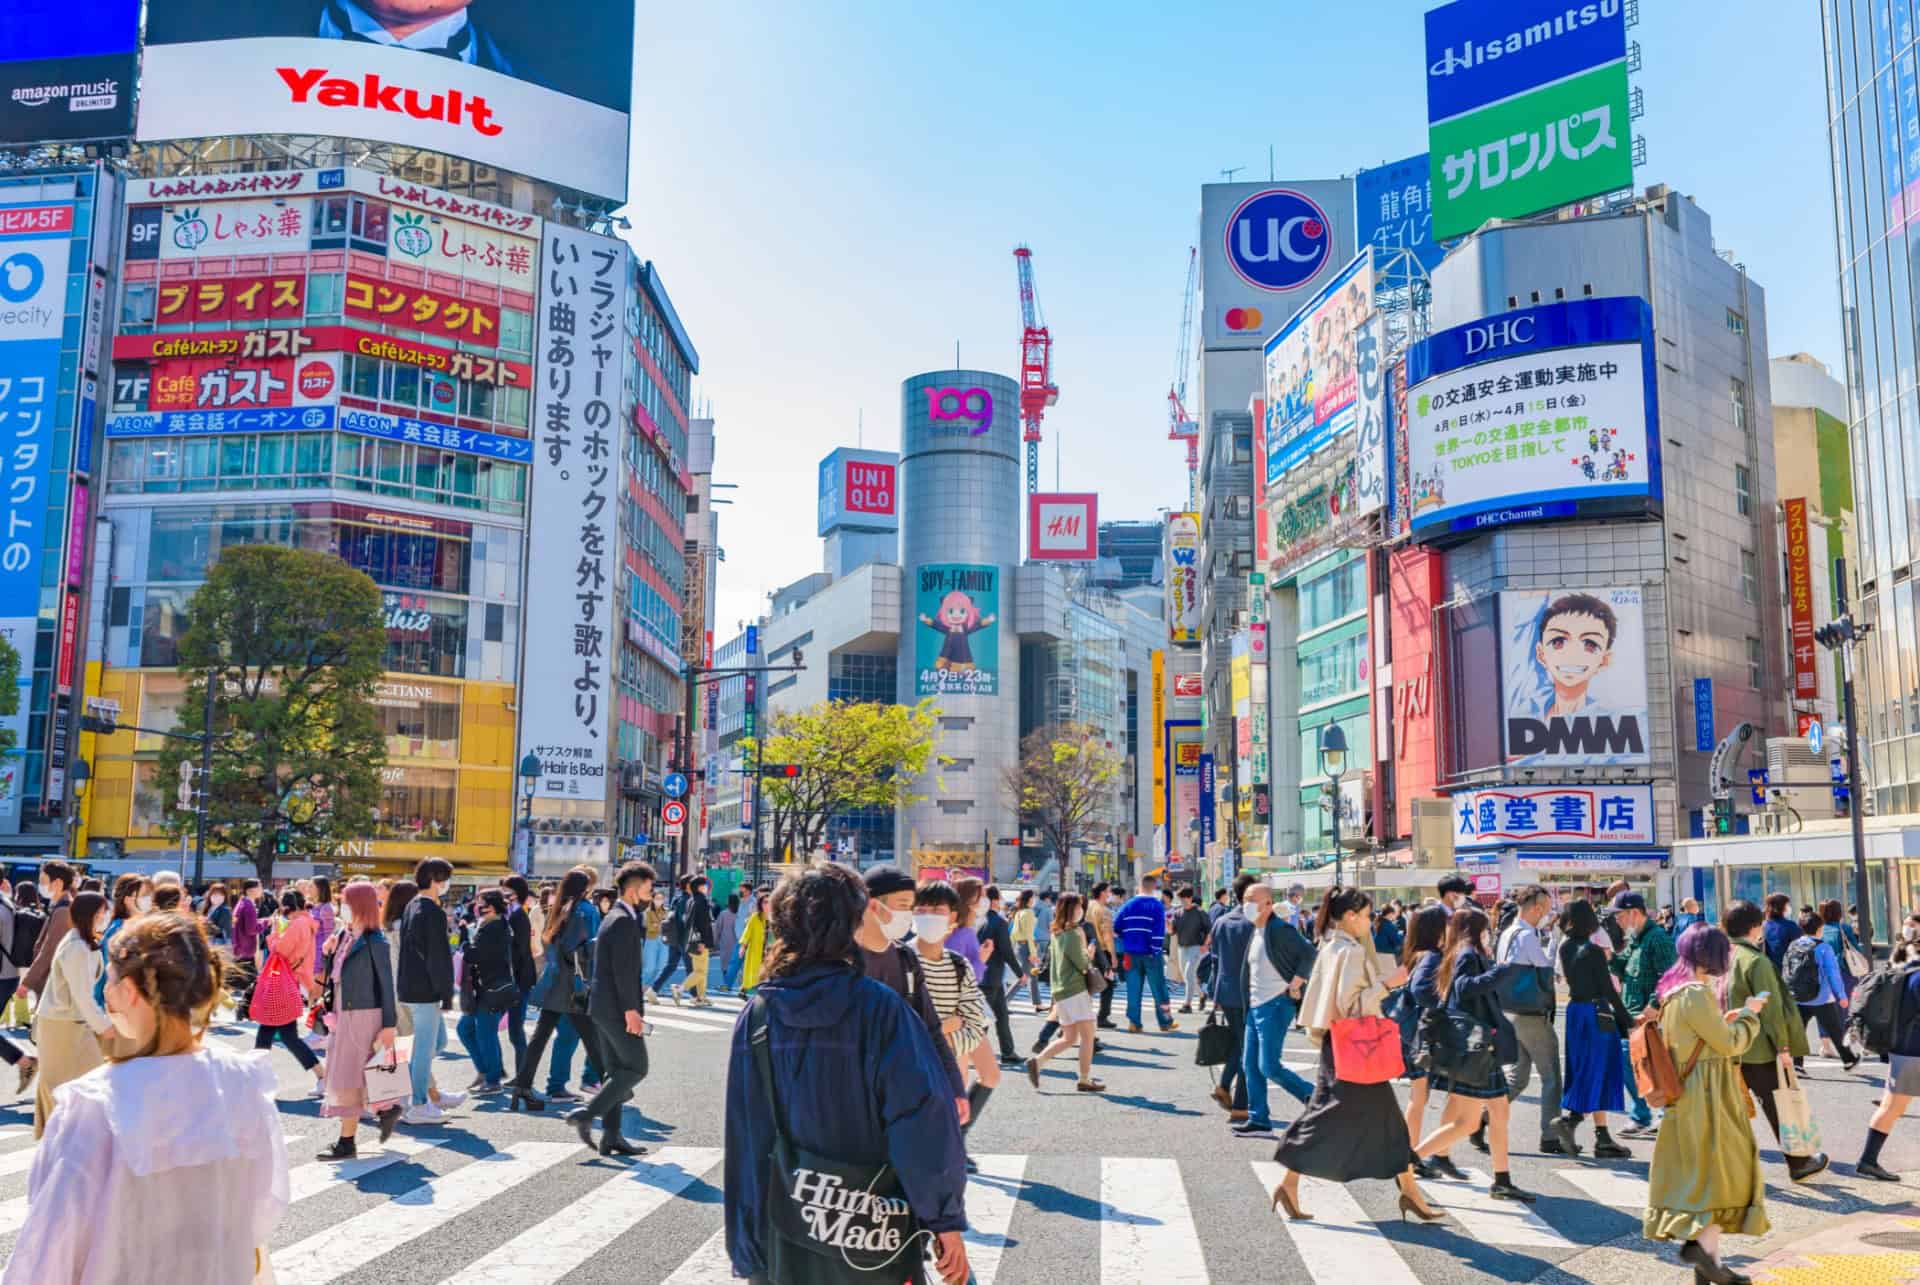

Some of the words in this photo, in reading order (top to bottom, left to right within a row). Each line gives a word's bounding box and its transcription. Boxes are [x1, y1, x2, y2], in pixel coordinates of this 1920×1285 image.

[1430, 0, 1619, 76] Hisamitsu
[12, 85, 68, 100] amazon
[71, 78, 118, 96] music
[277, 68, 503, 137] Yakult
[1442, 104, 1617, 200] サロンパス
[149, 173, 304, 198] しゃぶしゃぶバイキング
[379, 176, 534, 231] しゃぶしゃぶバイキング
[1380, 183, 1432, 221] 龍角
[131, 223, 159, 242] 9F
[214, 208, 302, 240] しゃぶ葉
[1239, 216, 1321, 263] UC
[440, 228, 531, 275] しゃぶ葉
[161, 279, 300, 314] プライス
[346, 280, 494, 336] コンタクト
[242, 329, 312, 358] ガスト
[1464, 316, 1536, 355] DHC
[450, 353, 518, 386] ガスト
[544, 237, 580, 481] いい曲あります。
[117, 378, 149, 400] 7F
[157, 376, 194, 393] Café
[197, 368, 286, 407] ガスト
[303, 378, 331, 389] ガスト
[113, 415, 155, 431] AEON
[168, 411, 296, 432] 英会話イーオン
[303, 410, 326, 425] 6F
[924, 386, 993, 436] 109
[346, 411, 394, 433] AEON
[403, 421, 530, 458] 英会話イーオン
[3, 377, 45, 572] コンタクトの
[573, 249, 619, 738] ブラジャーのホックを外す歌より、
[851, 467, 888, 488] UNI
[851, 489, 889, 509] QLO
[1475, 513, 1499, 527] DHC
[1500, 506, 1544, 521] Channel
[1047, 515, 1081, 537] H&M
[1791, 503, 1809, 612] クスリのことなら
[1507, 714, 1645, 756] DMM
[544, 760, 568, 775] Hair
[570, 761, 578, 776] is
[580, 763, 604, 777] Bad
[1459, 795, 1635, 834] 大盛堂書店
[789, 1168, 909, 1218] Human
[800, 1205, 900, 1251] Made
